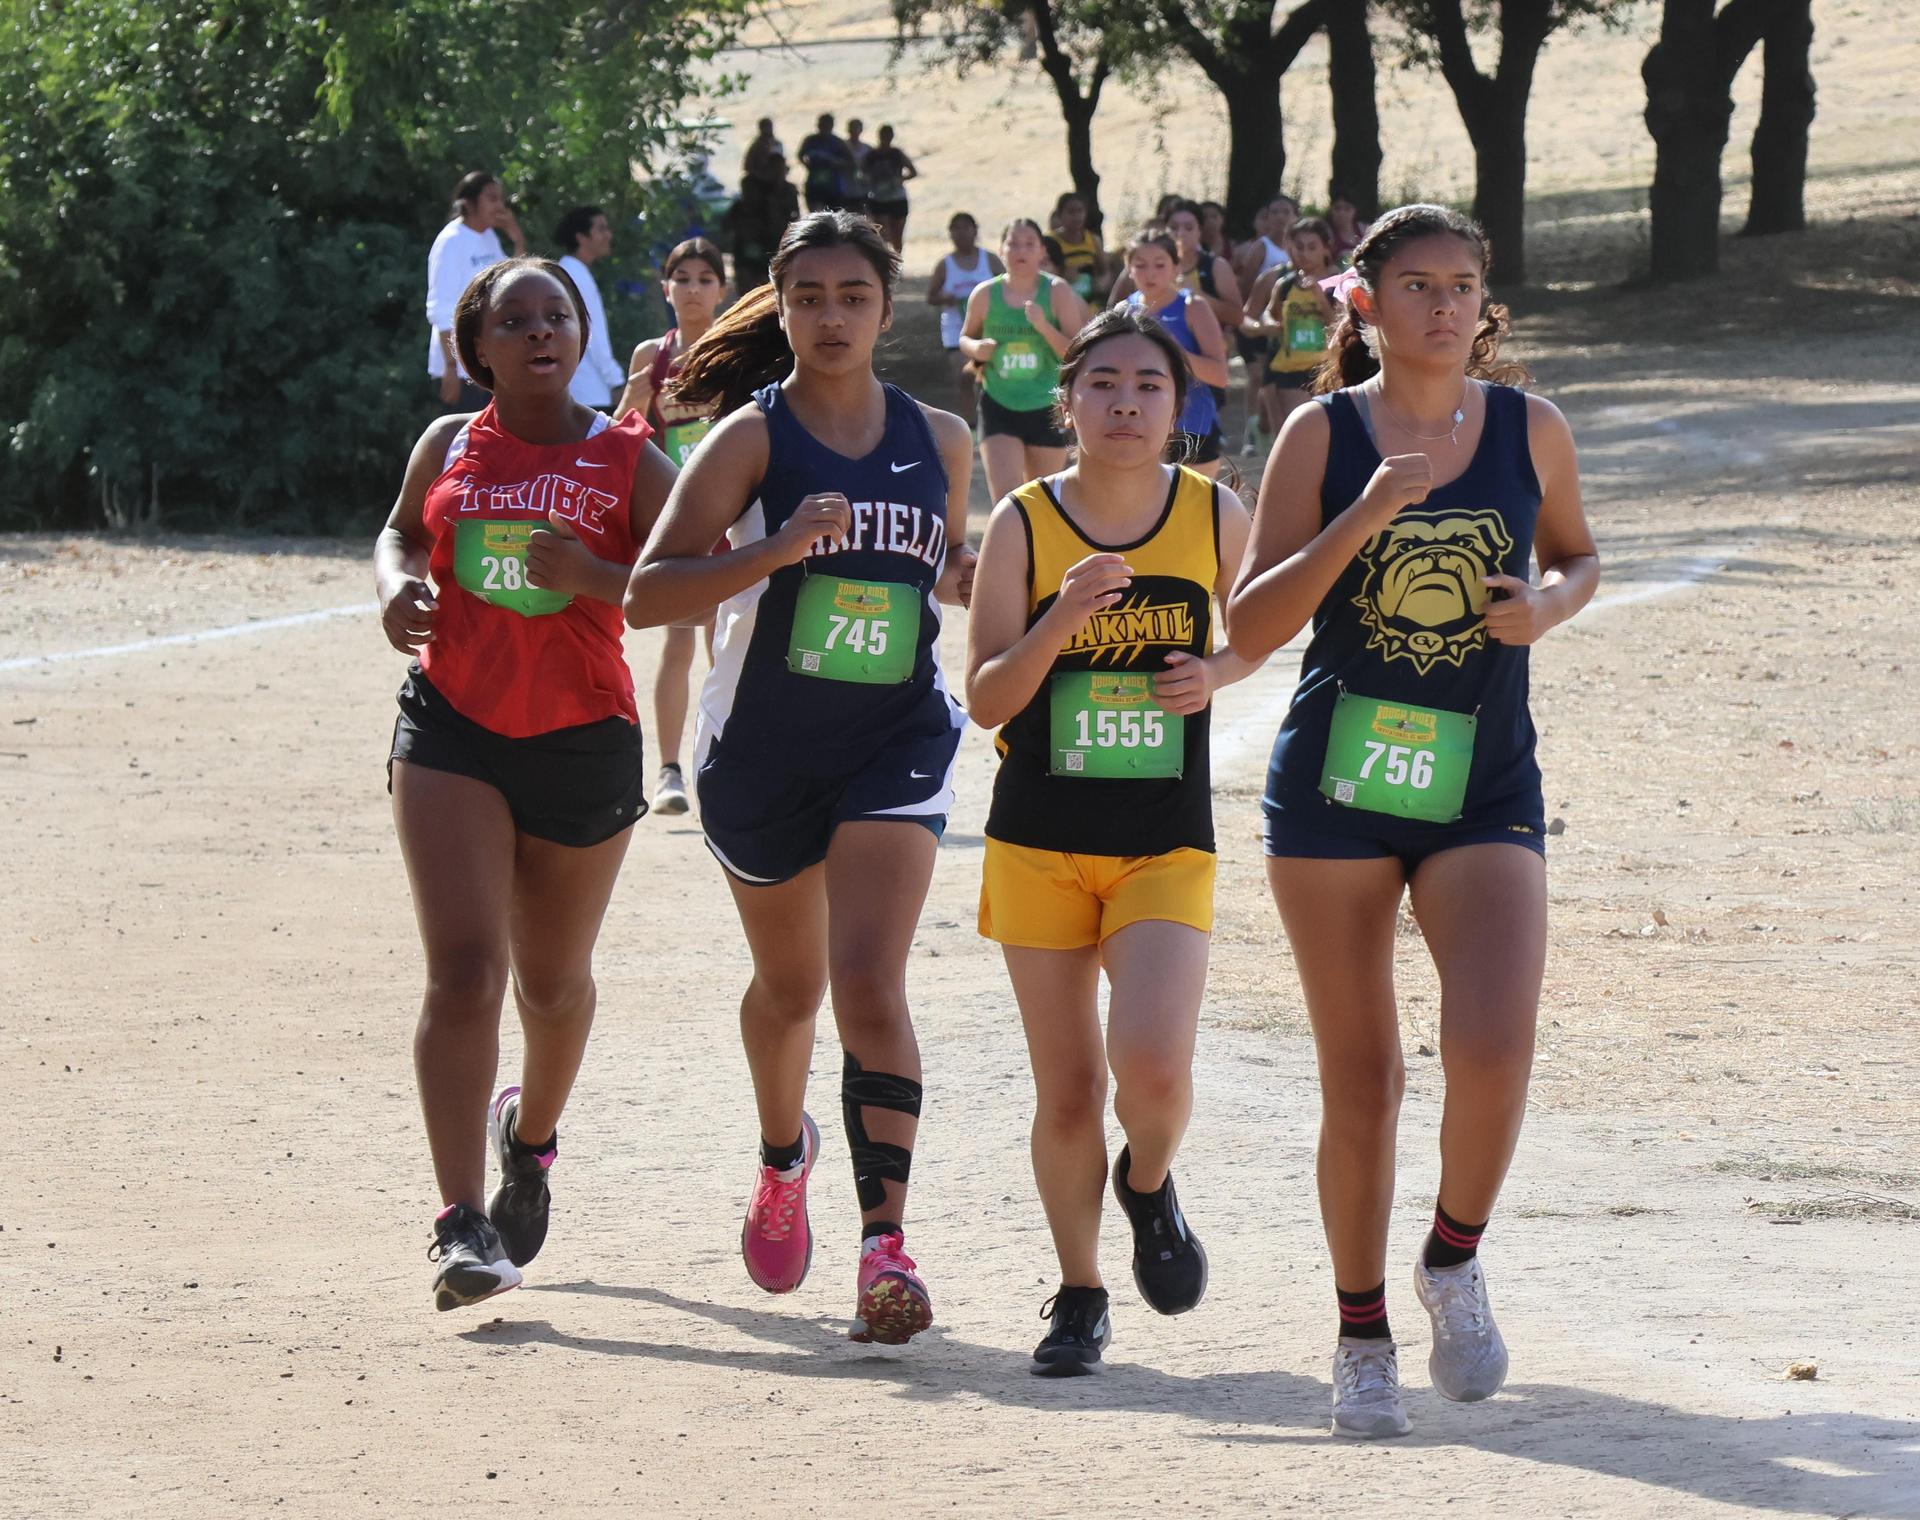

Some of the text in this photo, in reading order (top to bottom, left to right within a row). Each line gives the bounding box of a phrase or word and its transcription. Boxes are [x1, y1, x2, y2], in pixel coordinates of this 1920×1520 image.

[460, 474, 619, 535] TRIBE
[824, 614, 890, 656] 745
[1075, 710, 1164, 748] 1555
[1359, 740, 1436, 789] 756
